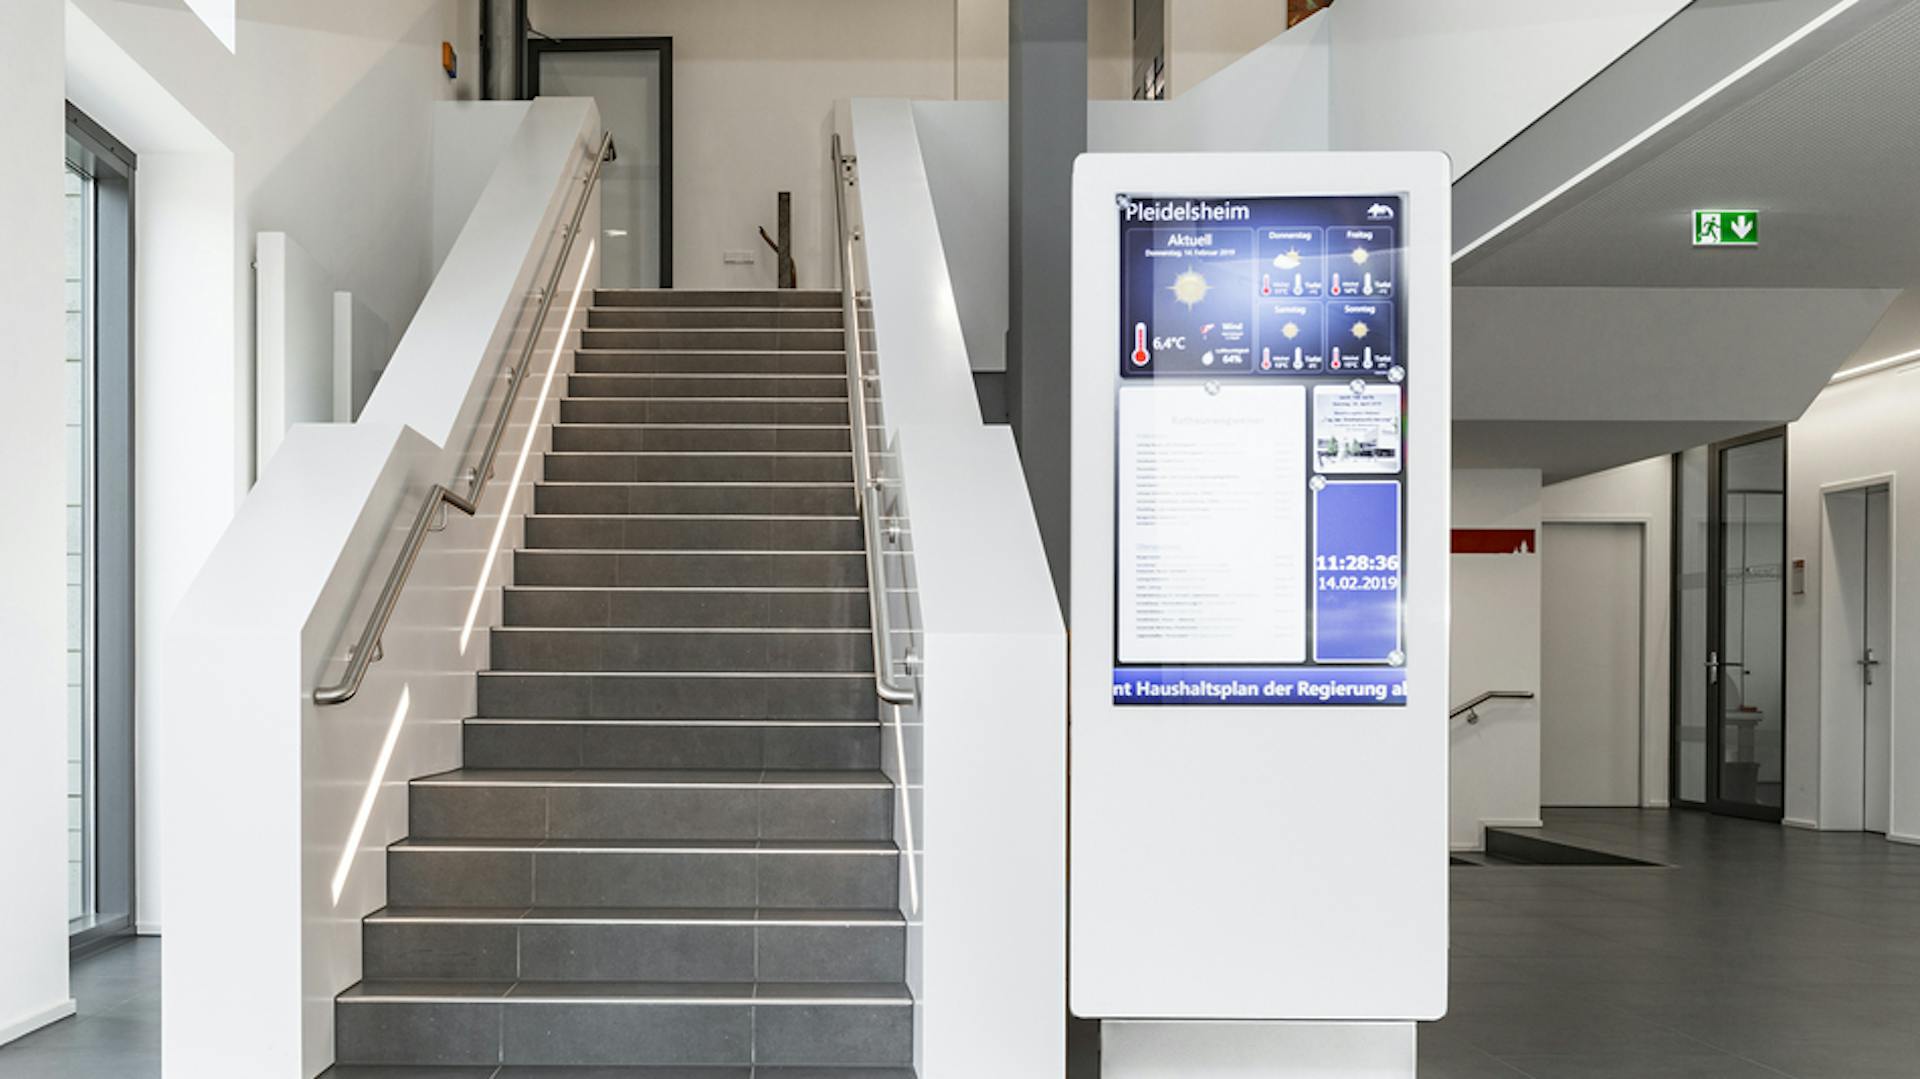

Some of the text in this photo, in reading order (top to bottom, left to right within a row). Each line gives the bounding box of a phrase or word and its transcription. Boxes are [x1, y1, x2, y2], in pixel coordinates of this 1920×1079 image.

[1125, 202, 1250, 221] Pleidelsheim
[1167, 233, 1213, 248] Aktuell
[1347, 231, 1374, 241] Freitag
[1344, 305, 1376, 315] Sonntag
[1152, 336, 1187, 351] 6,4°C
[1316, 554, 1399, 571] 11:28:36
[1318, 576, 1399, 590] 14.02.2019
[1136, 680, 1259, 700] Haushaltsplan
[1262, 680, 1293, 696] der
[1297, 680, 1387, 700] Regierung
